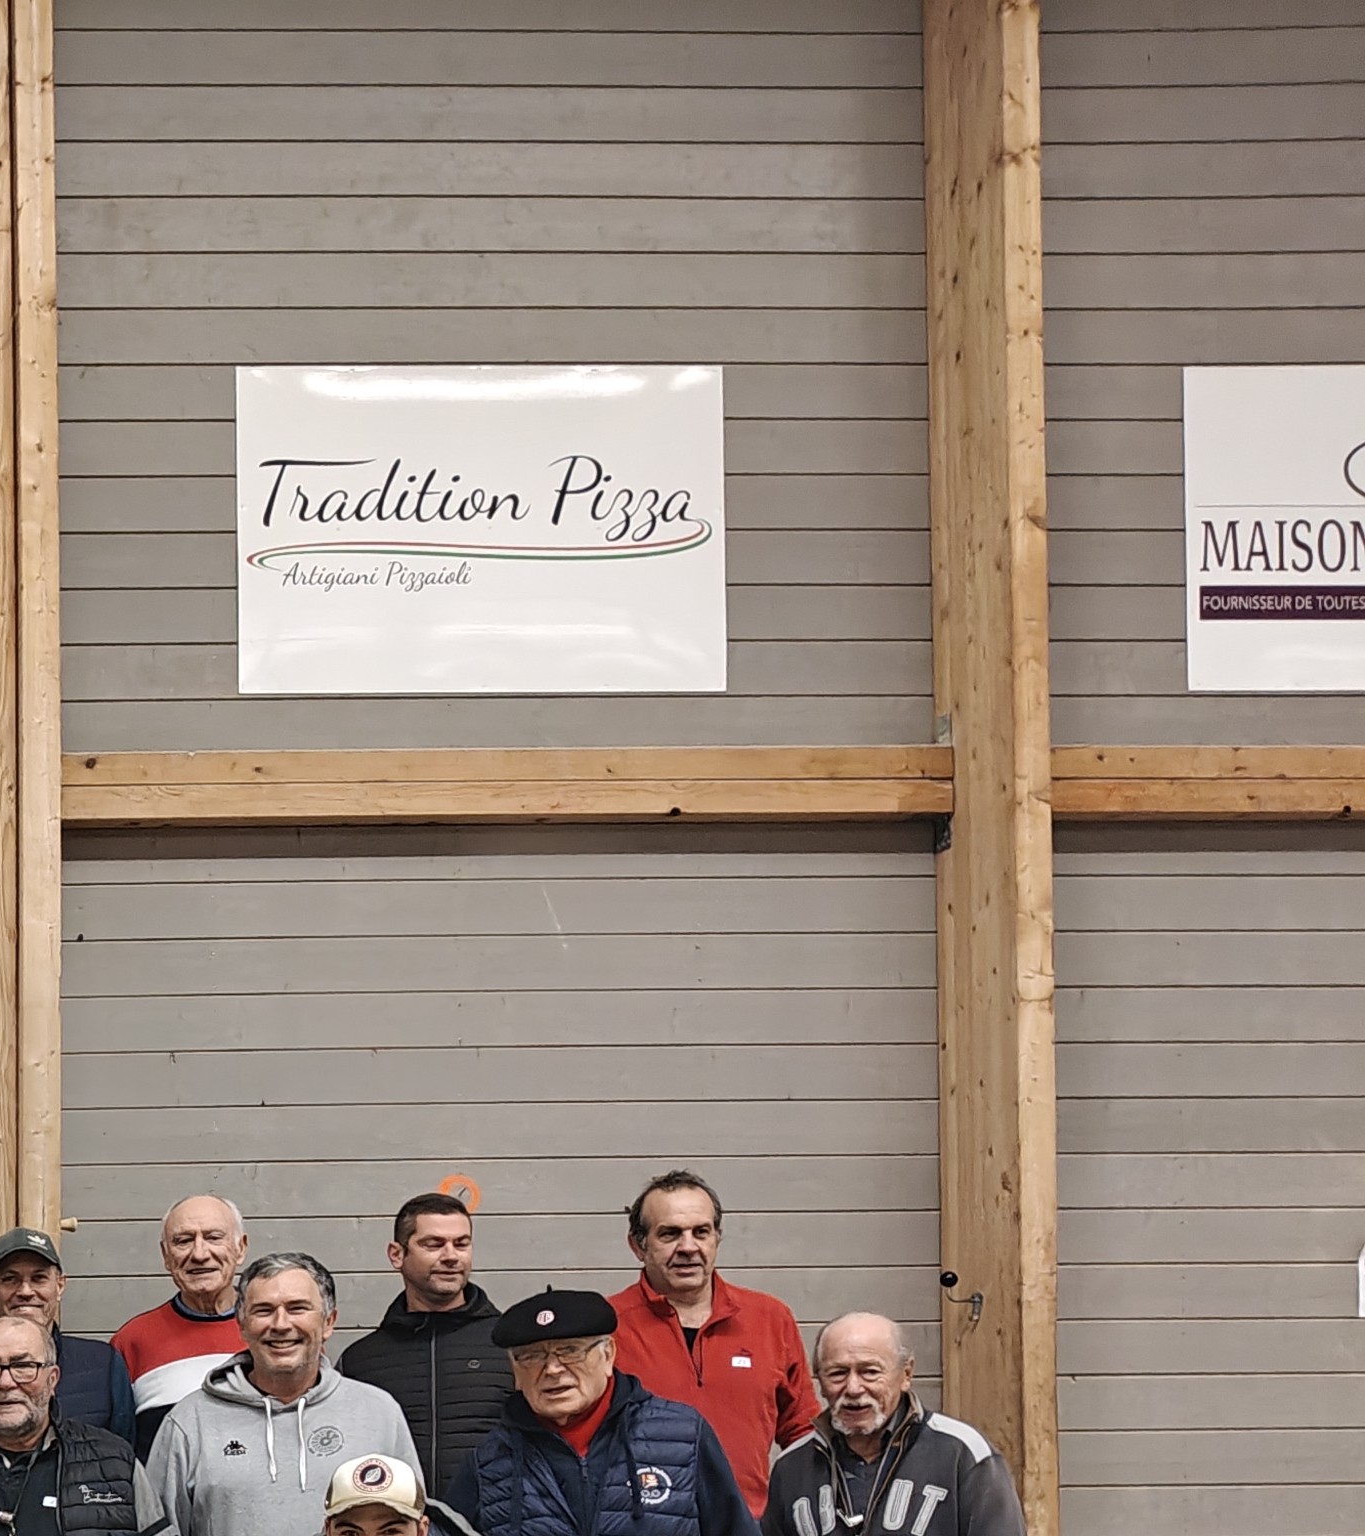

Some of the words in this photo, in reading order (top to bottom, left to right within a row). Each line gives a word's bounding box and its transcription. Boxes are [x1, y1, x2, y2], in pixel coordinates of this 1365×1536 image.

[258, 457, 532, 527] Tradition
[547, 454, 696, 543] Pizza
[281, 561, 381, 592] Artigiani
[385, 560, 472, 593] Pizzaioli
[1202, 595, 1292, 610] FOURNISSEUR
[1295, 595, 1313, 610] DE
[1316, 595, 1365, 610] TOUTES
